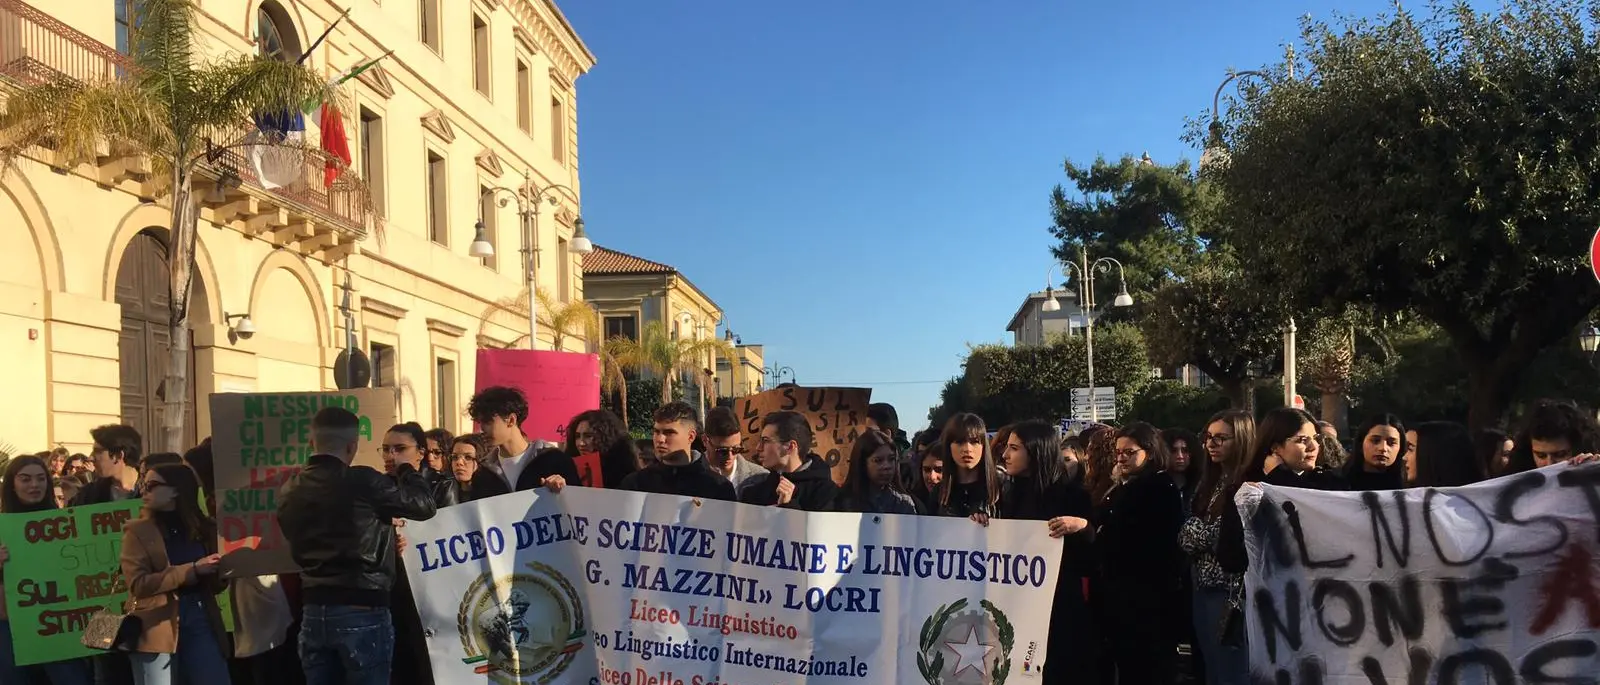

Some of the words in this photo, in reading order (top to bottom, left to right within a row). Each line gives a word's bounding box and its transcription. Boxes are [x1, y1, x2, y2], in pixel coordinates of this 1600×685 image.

[239, 420, 264, 446] CI
[415, 526, 505, 572] LICEO
[597, 518, 716, 559] SCIENZE
[726, 532, 827, 574] UMANE
[836, 544, 853, 574] E
[863, 545, 1047, 587] LINGUISTICO
[17, 578, 69, 608] SUL
[585, 559, 610, 586] G.
[783, 582, 881, 613] LOCRI
[630, 598, 680, 625] Liceo
[688, 604, 798, 640] Linguistico
[600, 661, 632, 684] iceo
[614, 629, 719, 661] Linguistico
[724, 642, 868, 677] Internazionale
